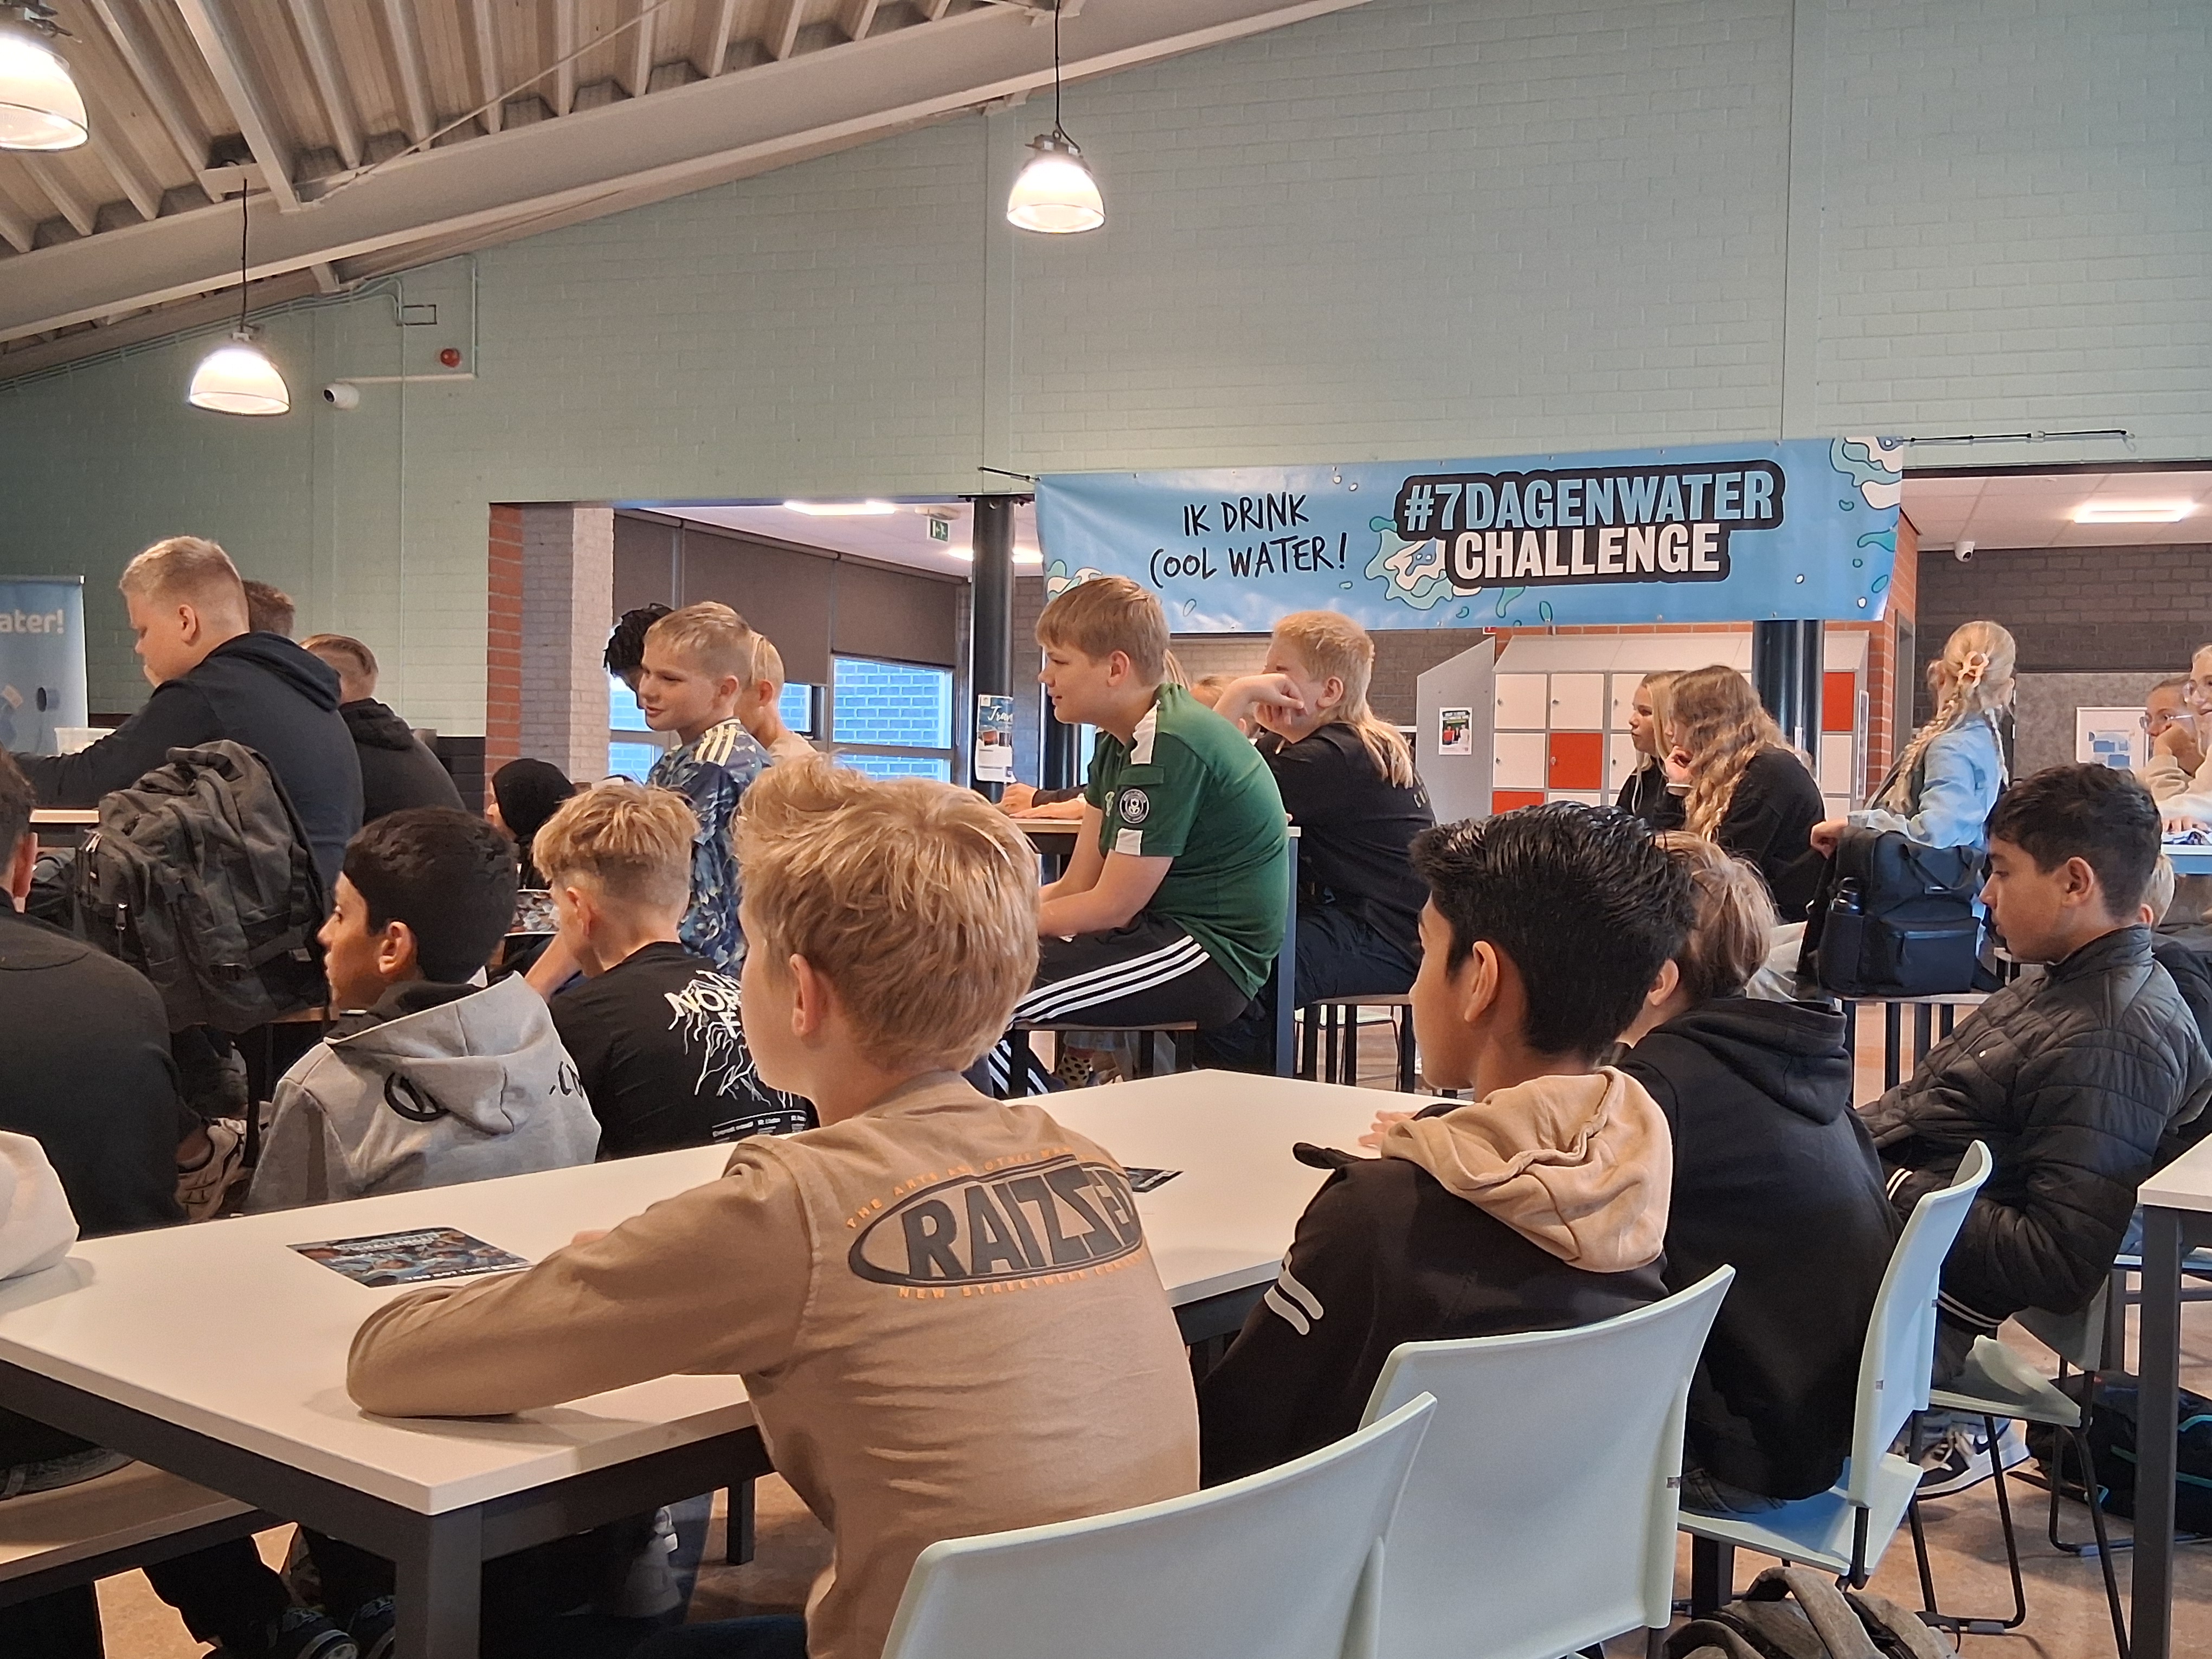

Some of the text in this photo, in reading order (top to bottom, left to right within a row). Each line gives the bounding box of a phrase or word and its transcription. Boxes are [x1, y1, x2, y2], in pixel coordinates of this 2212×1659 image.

[1183, 491, 1310, 537] IK DRINK
[1404, 470, 1775, 532] #7DAGENWATER
[1149, 532, 1348, 589] COOL WATER!
[1454, 523, 1722, 580] CHALLENGE
[664, 988, 742, 1017] NOR
[899, 1287, 945, 1299] NEW
